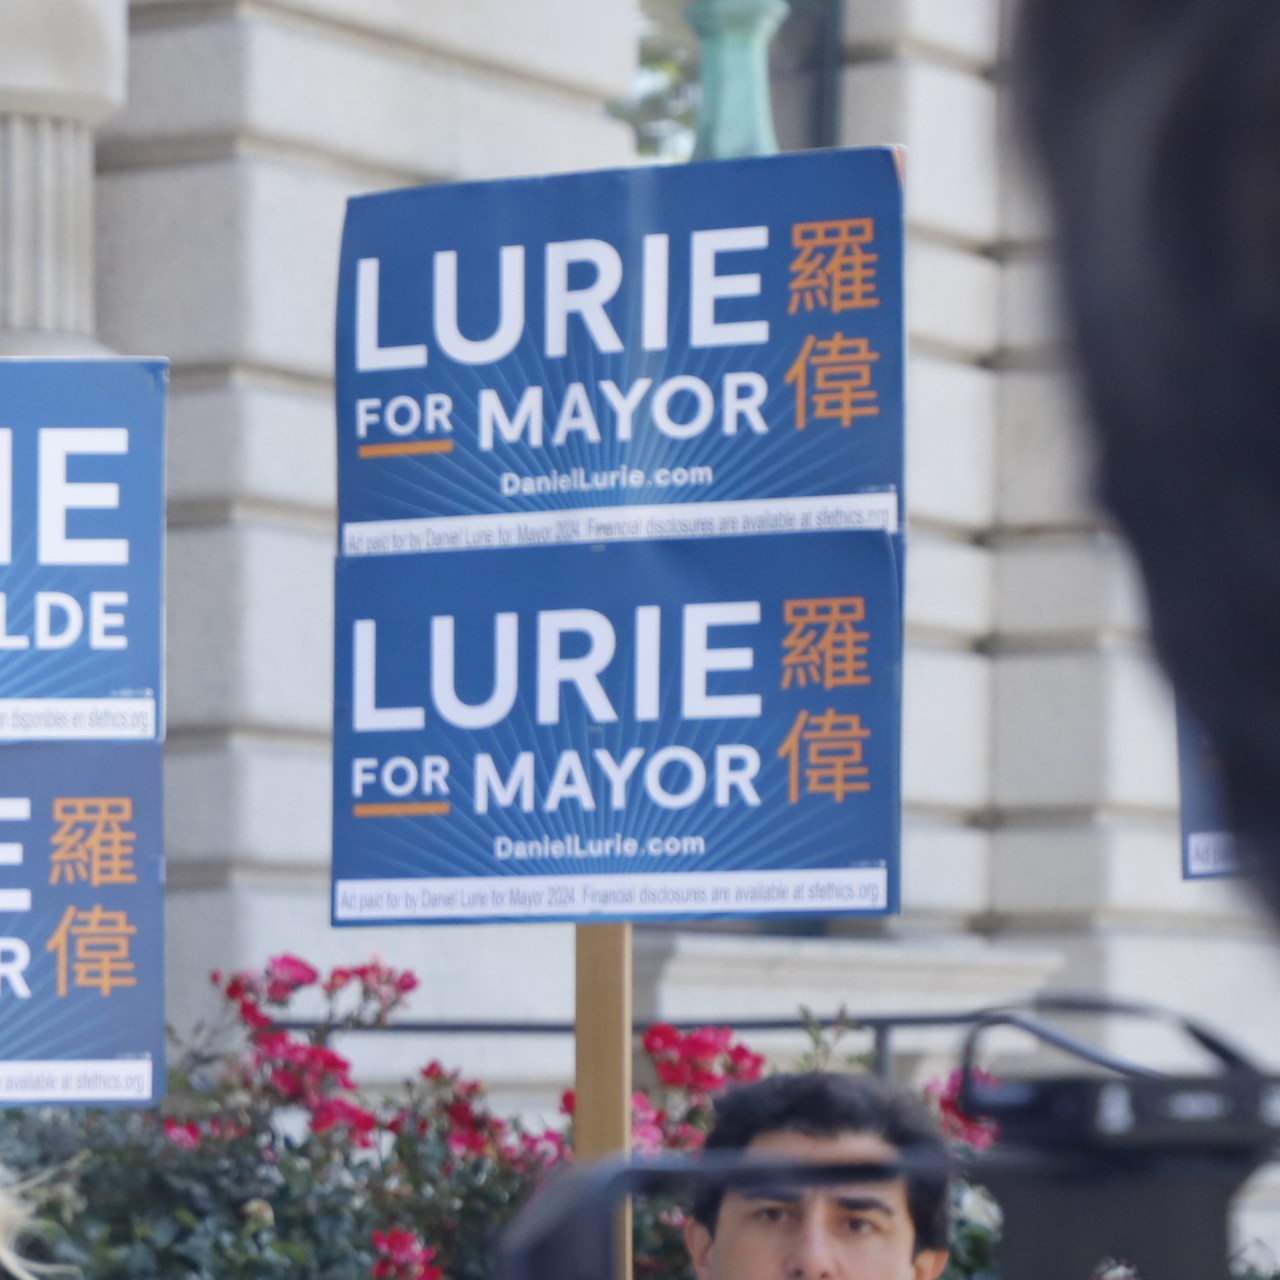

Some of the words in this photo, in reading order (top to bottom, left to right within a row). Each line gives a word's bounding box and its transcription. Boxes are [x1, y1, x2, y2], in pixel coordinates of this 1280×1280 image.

[356, 226, 769, 373] LURIE
[357, 394, 452, 437] FOR
[478, 371, 769, 451] MAYOR
[499, 462, 715, 498] DanielLurie.com
[354, 602, 761, 731] LURIE
[353, 756, 449, 796] FOR
[475, 745, 760, 813] MAYOR
[493, 831, 707, 861] DanielLurie.com
